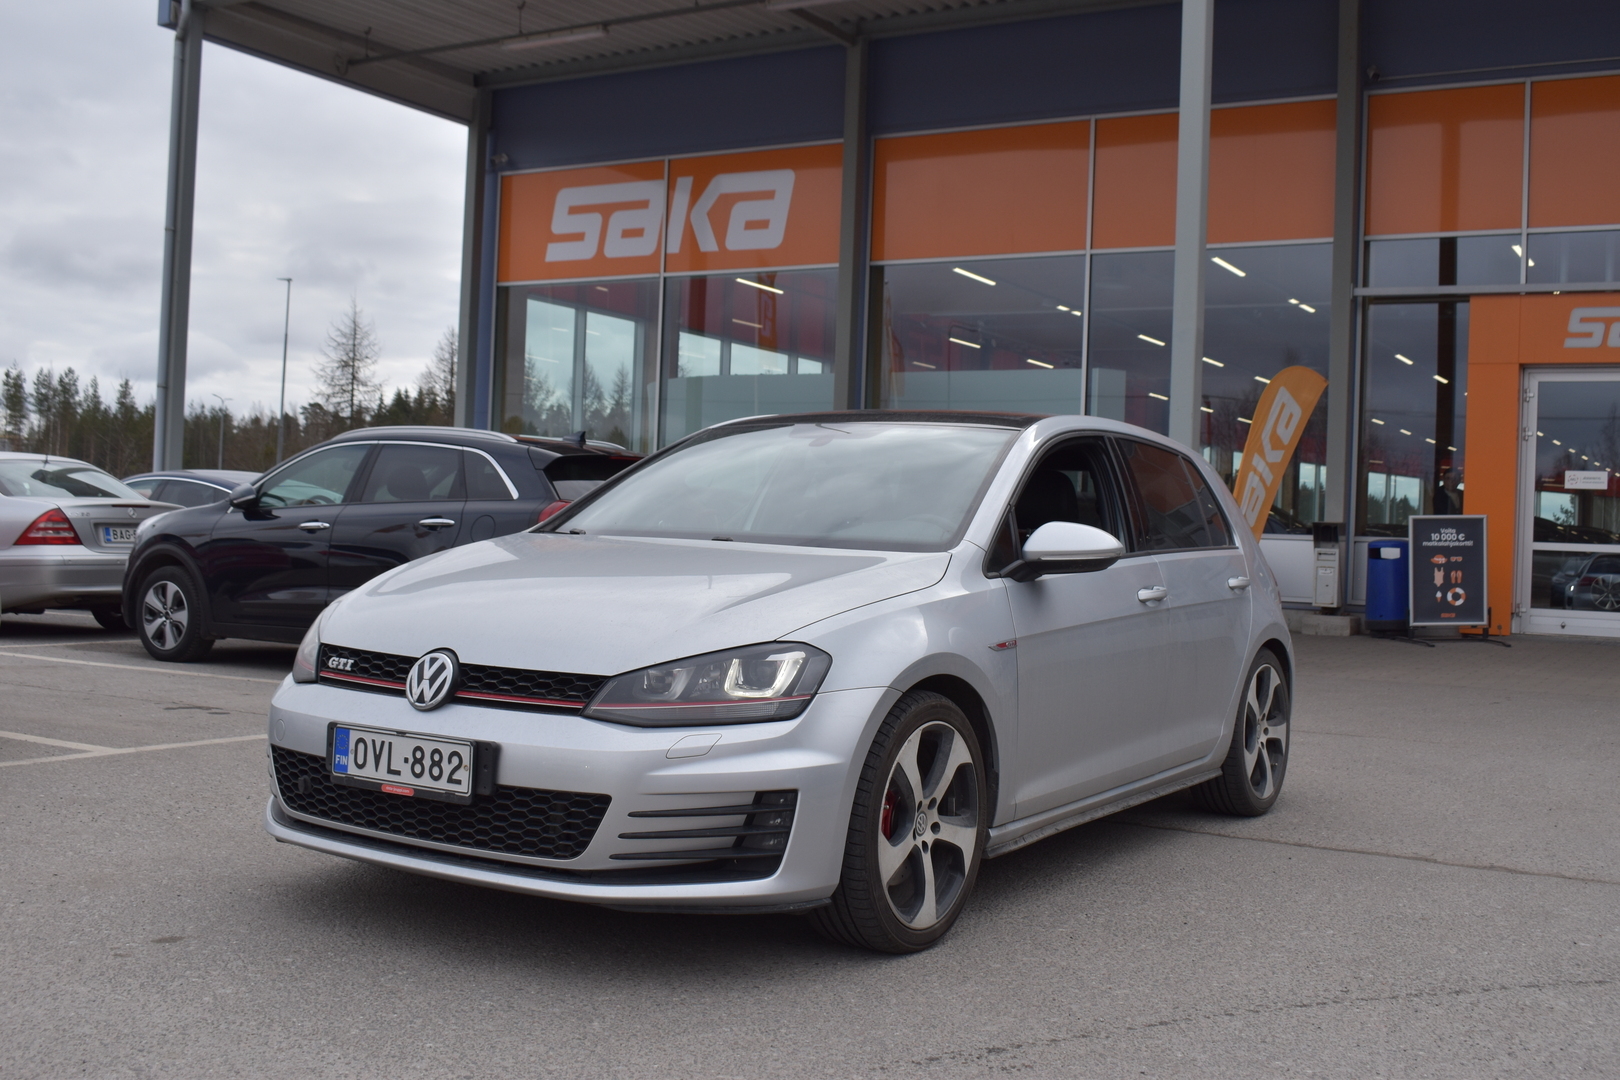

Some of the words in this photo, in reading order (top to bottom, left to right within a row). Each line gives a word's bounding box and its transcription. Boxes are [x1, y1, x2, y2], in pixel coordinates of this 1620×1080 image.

[1431, 533, 1440, 541] 10
[1441, 533, 1457, 541] 000
[1458, 533, 1465, 541] €
[328, 656, 355, 671] GTI
[335, 754, 348, 766] FIN
[354, 737, 463, 785] OVL-882
